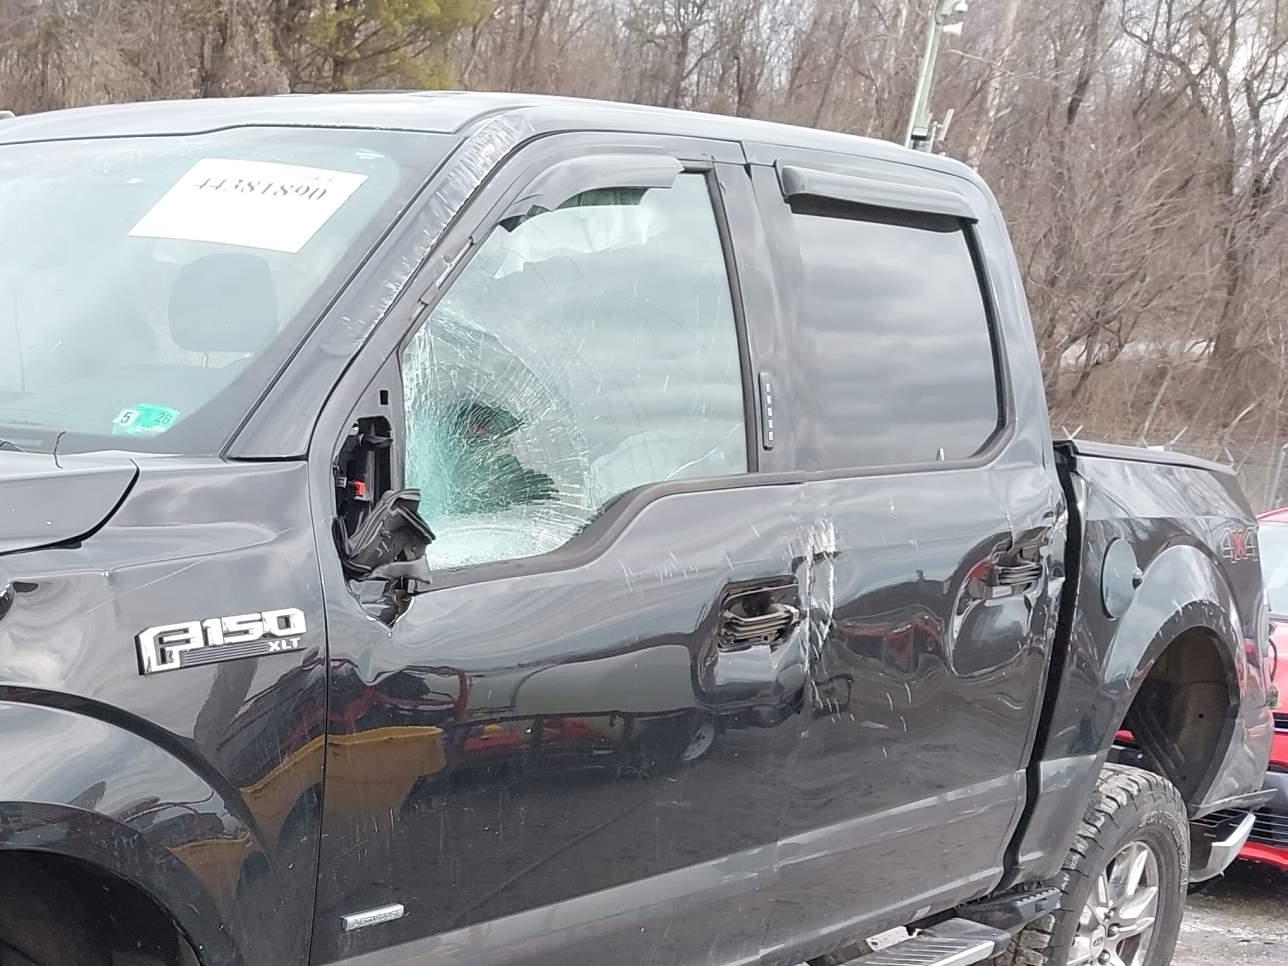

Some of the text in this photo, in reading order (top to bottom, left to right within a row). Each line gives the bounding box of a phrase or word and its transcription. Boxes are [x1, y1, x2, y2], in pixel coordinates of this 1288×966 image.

[120, 411, 173, 425] 5 26
[268, 637, 301, 652] XLT
